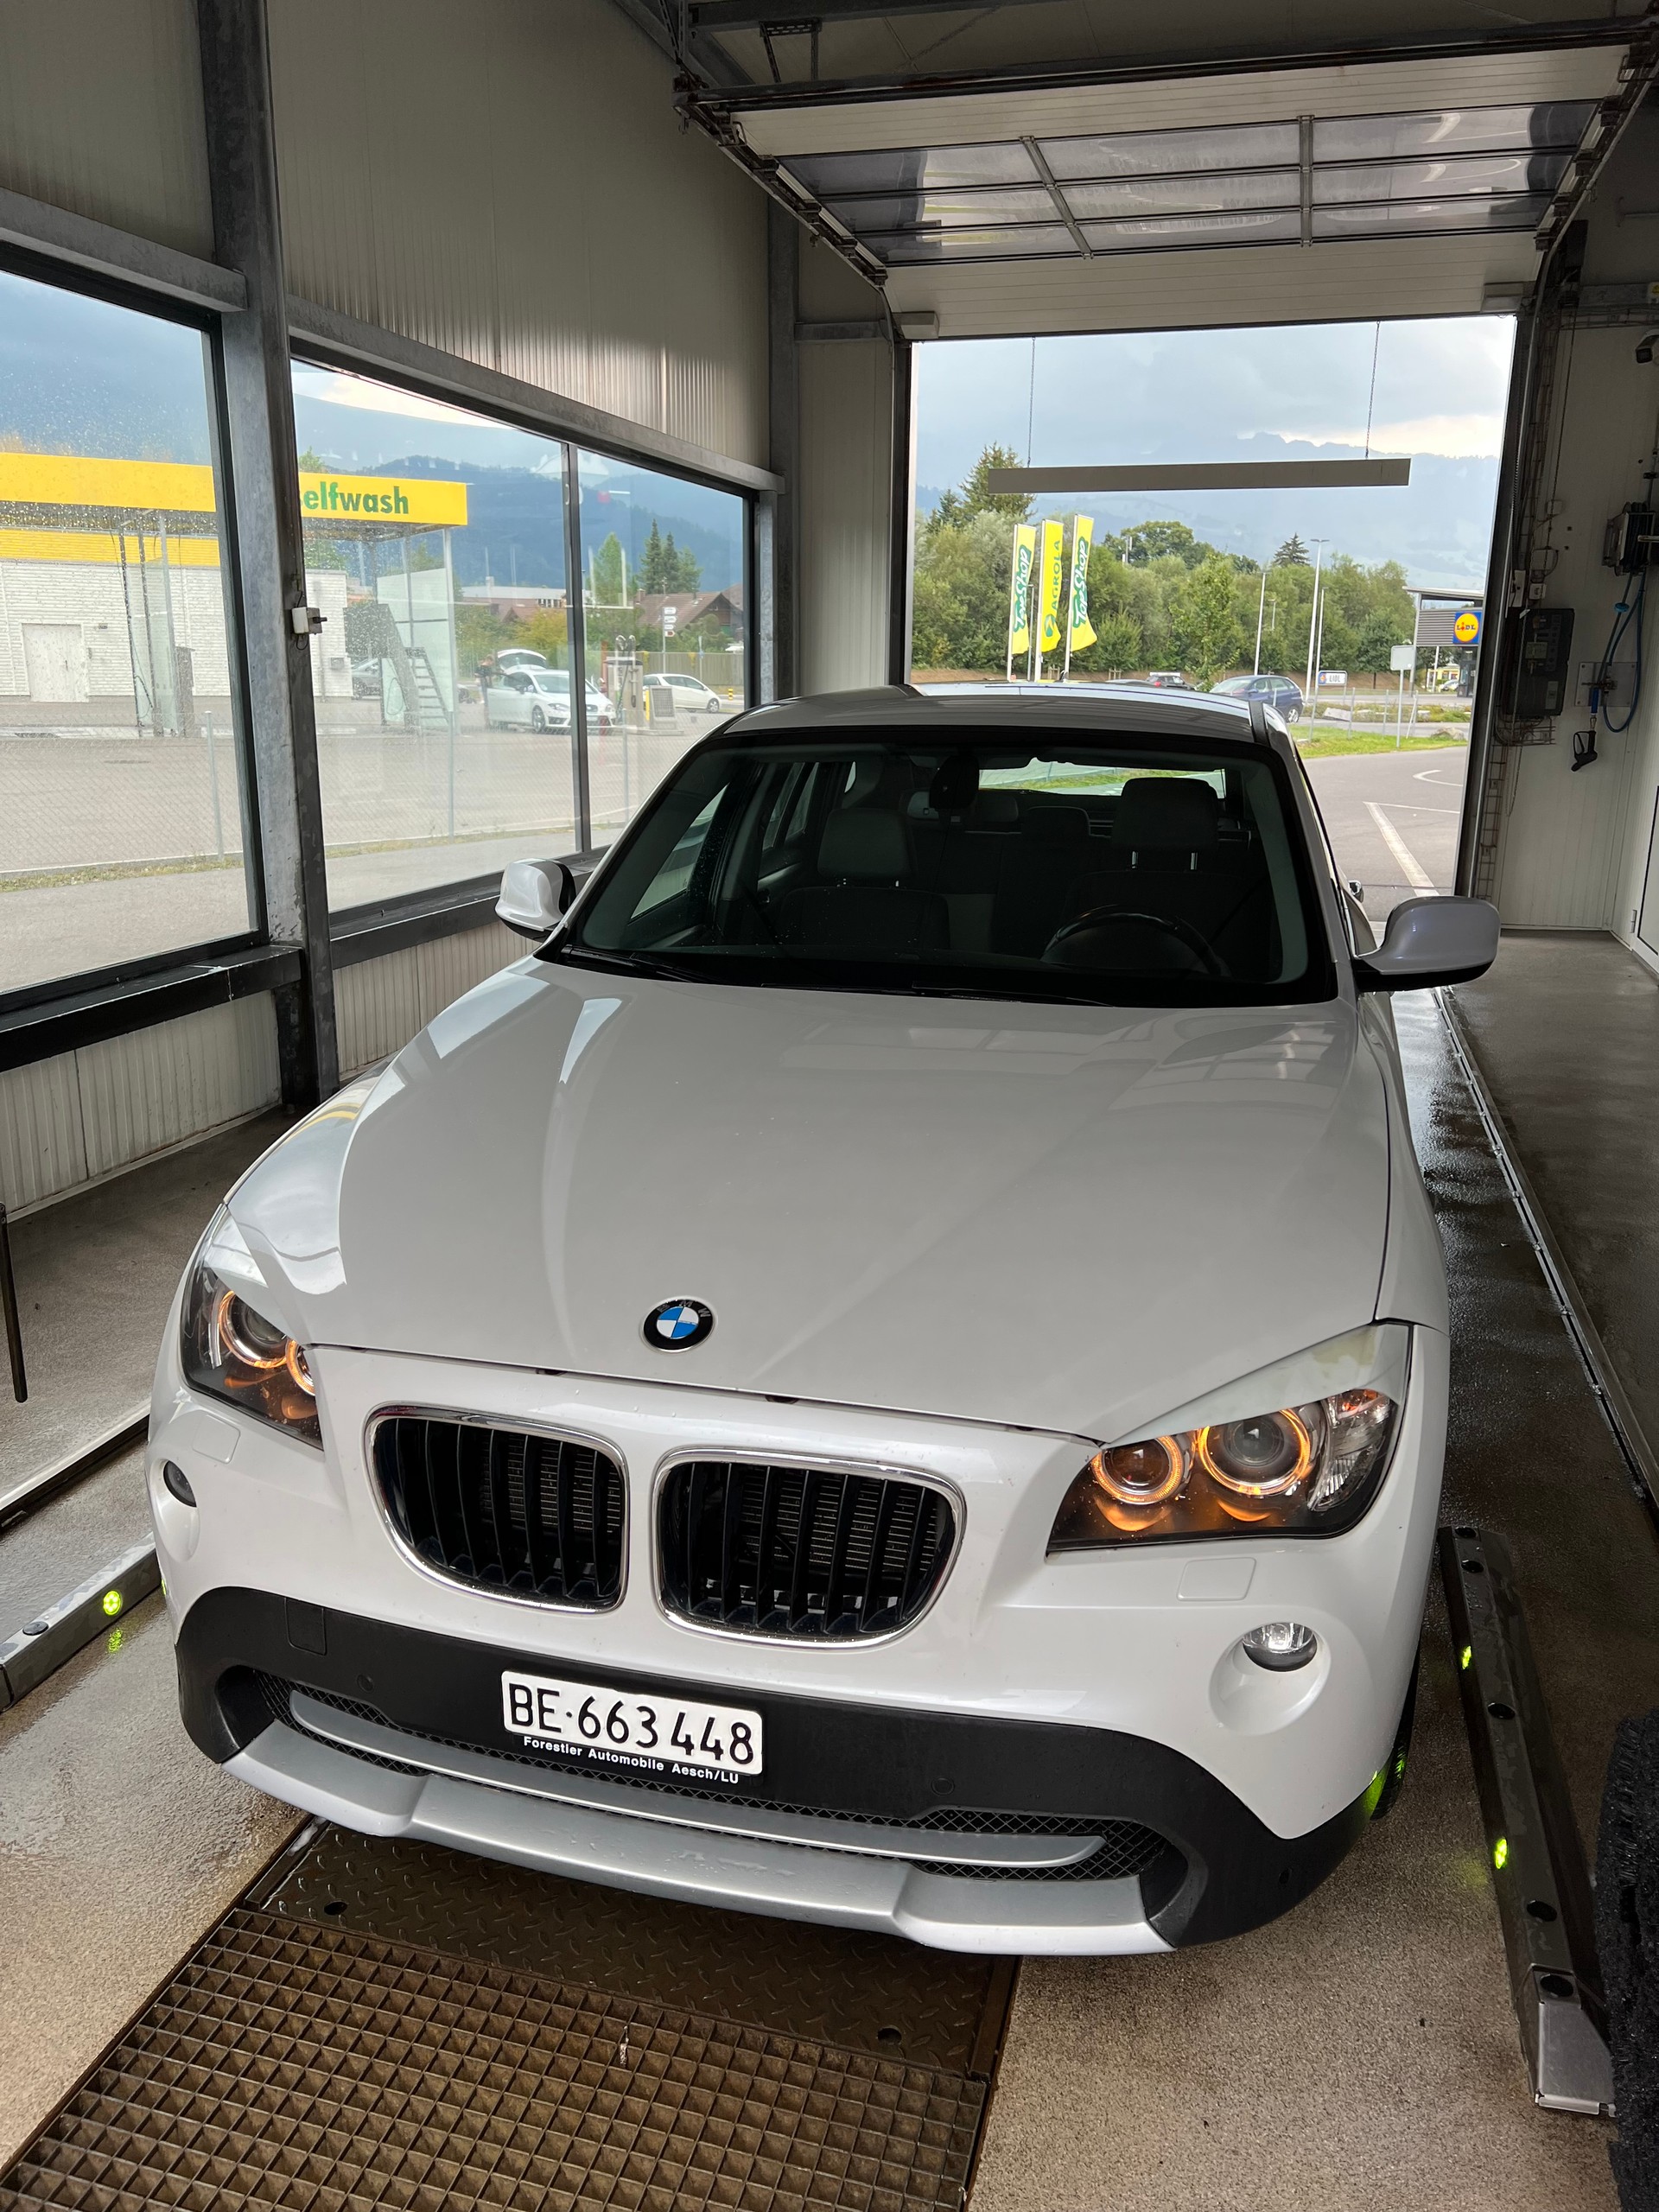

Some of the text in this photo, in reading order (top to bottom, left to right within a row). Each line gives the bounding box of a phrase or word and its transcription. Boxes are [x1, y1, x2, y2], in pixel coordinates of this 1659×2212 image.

[301, 480, 410, 515] elfwash
[1051, 540, 1062, 611] AGROLA
[657, 1300, 711, 1318] BMW
[523, 1735, 740, 1784] Forestier Automobile Aesch/LU
